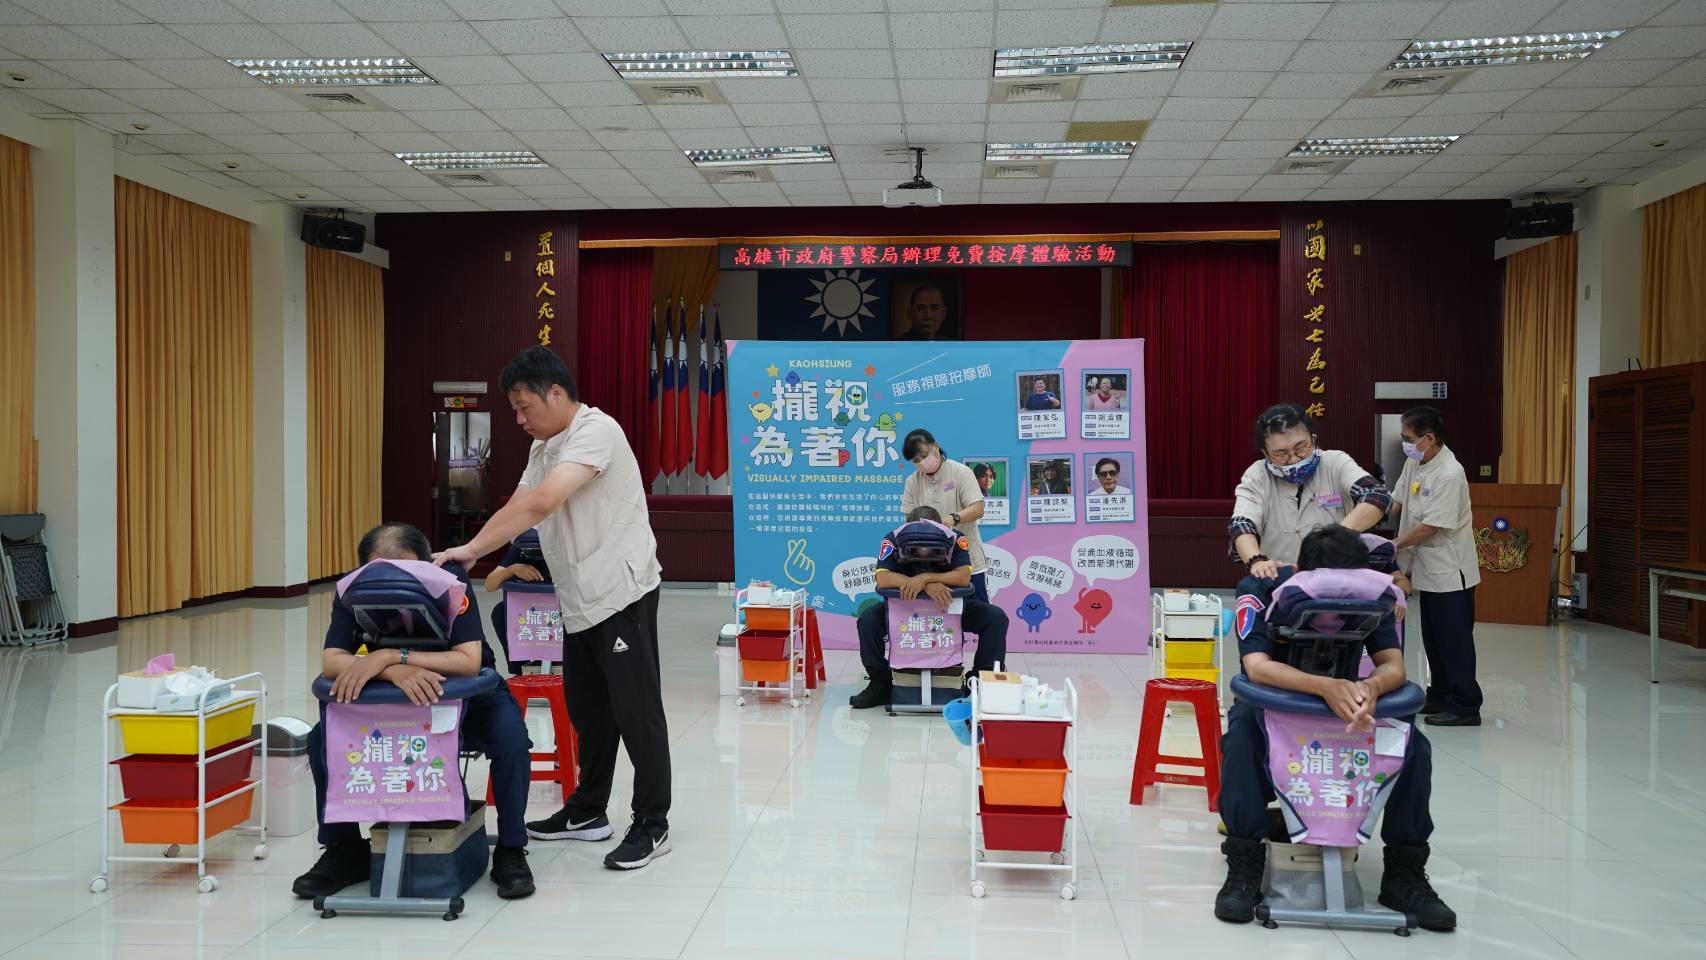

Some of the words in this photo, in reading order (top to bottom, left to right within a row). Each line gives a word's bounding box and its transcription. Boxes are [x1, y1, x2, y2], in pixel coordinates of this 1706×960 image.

[734, 244, 1117, 266] 高雄市政府警察局辦理免費按摩體驗活動
[789, 359, 853, 369] KAOHSIUNG
[891, 363, 992, 398] 服務視障按摩師
[750, 426, 900, 468] 為著你
[747, 474, 797, 483] VISUALLY
[800, 474, 852, 483] IMPAIRED
[855, 474, 904, 483] MASSAGE
[1077, 548, 1134, 558] 促進血液循環
